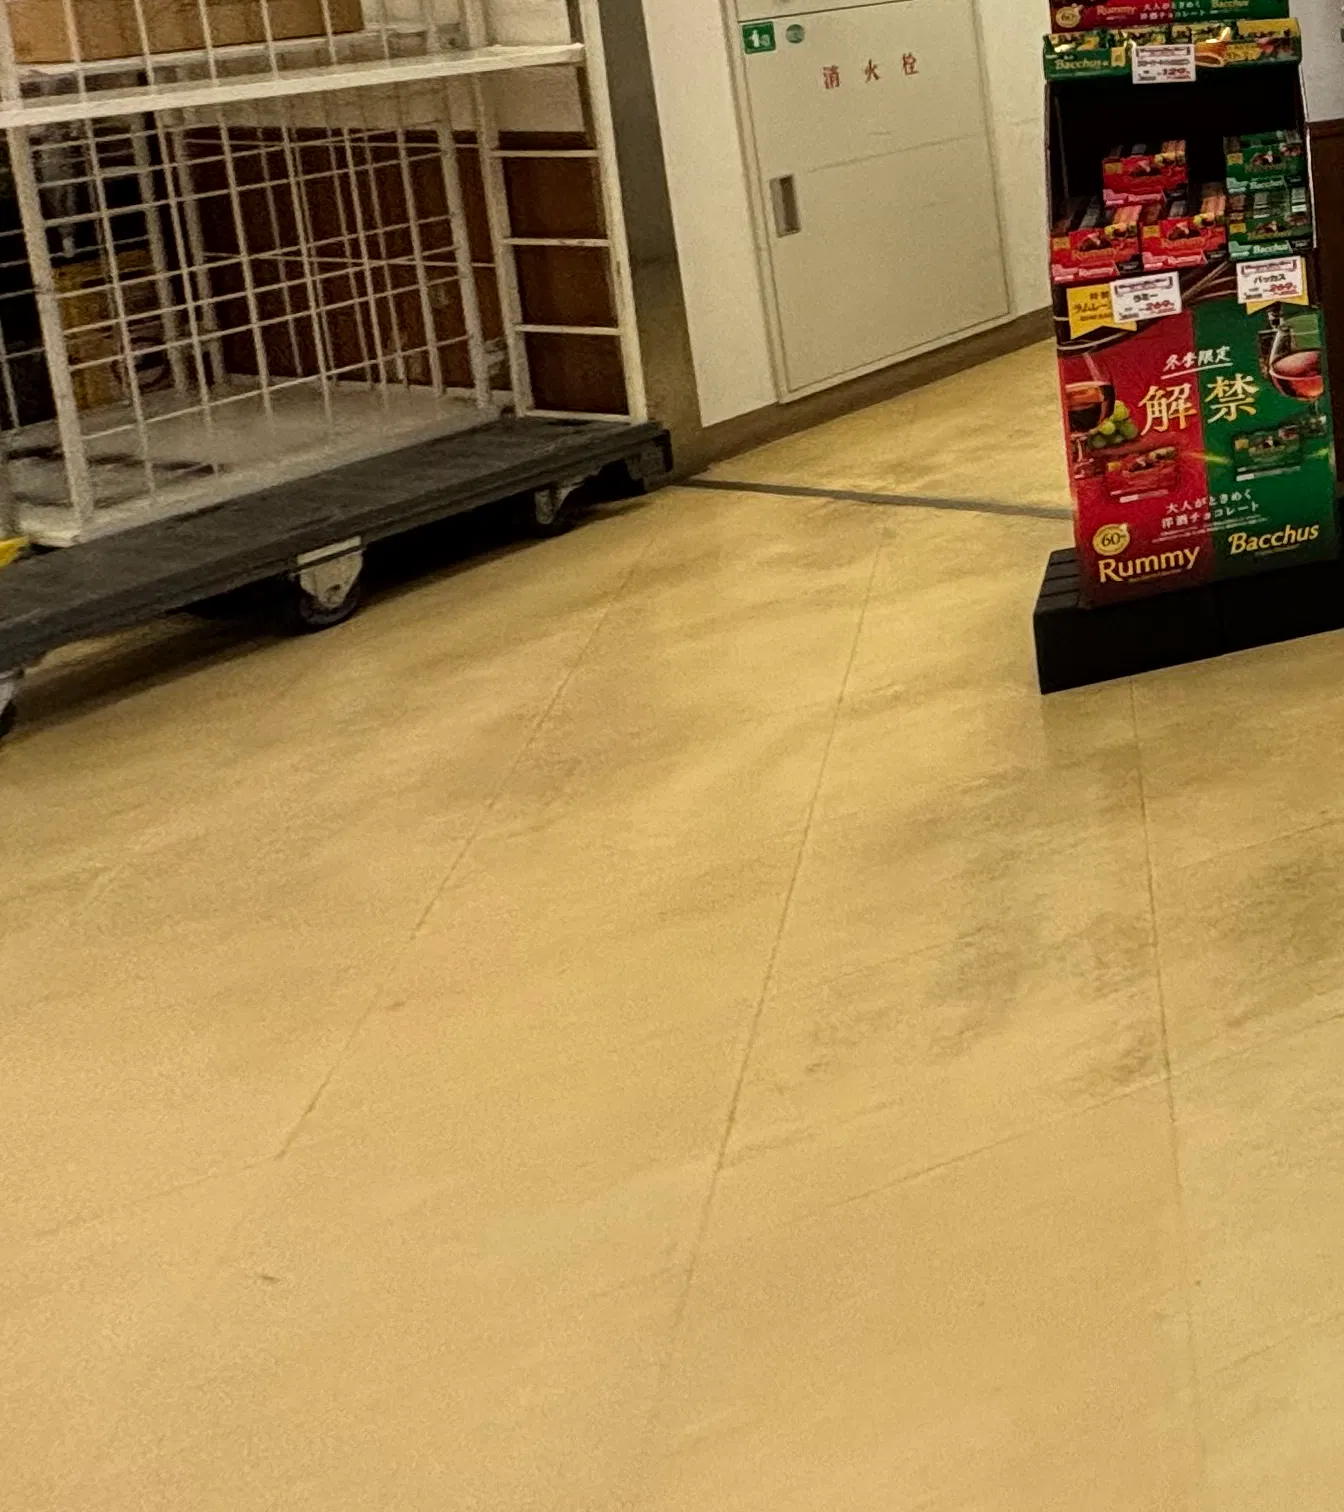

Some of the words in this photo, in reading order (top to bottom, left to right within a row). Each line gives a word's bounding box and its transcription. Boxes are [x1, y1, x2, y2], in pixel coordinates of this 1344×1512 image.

[822, 52, 919, 89] 消火栓
[1253, 273, 1287, 286] バッカス
[1132, 292, 1159, 304] ラミー
[1163, 344, 1232, 372] 冬季限定
[1137, 372, 1261, 437] 解禁
[1160, 500, 1260, 529] 洋酒チョコレート
[1165, 487, 1253, 515] 大人がときめく
[1228, 523, 1320, 556] Bacchus
[1098, 545, 1200, 584] Rummy
